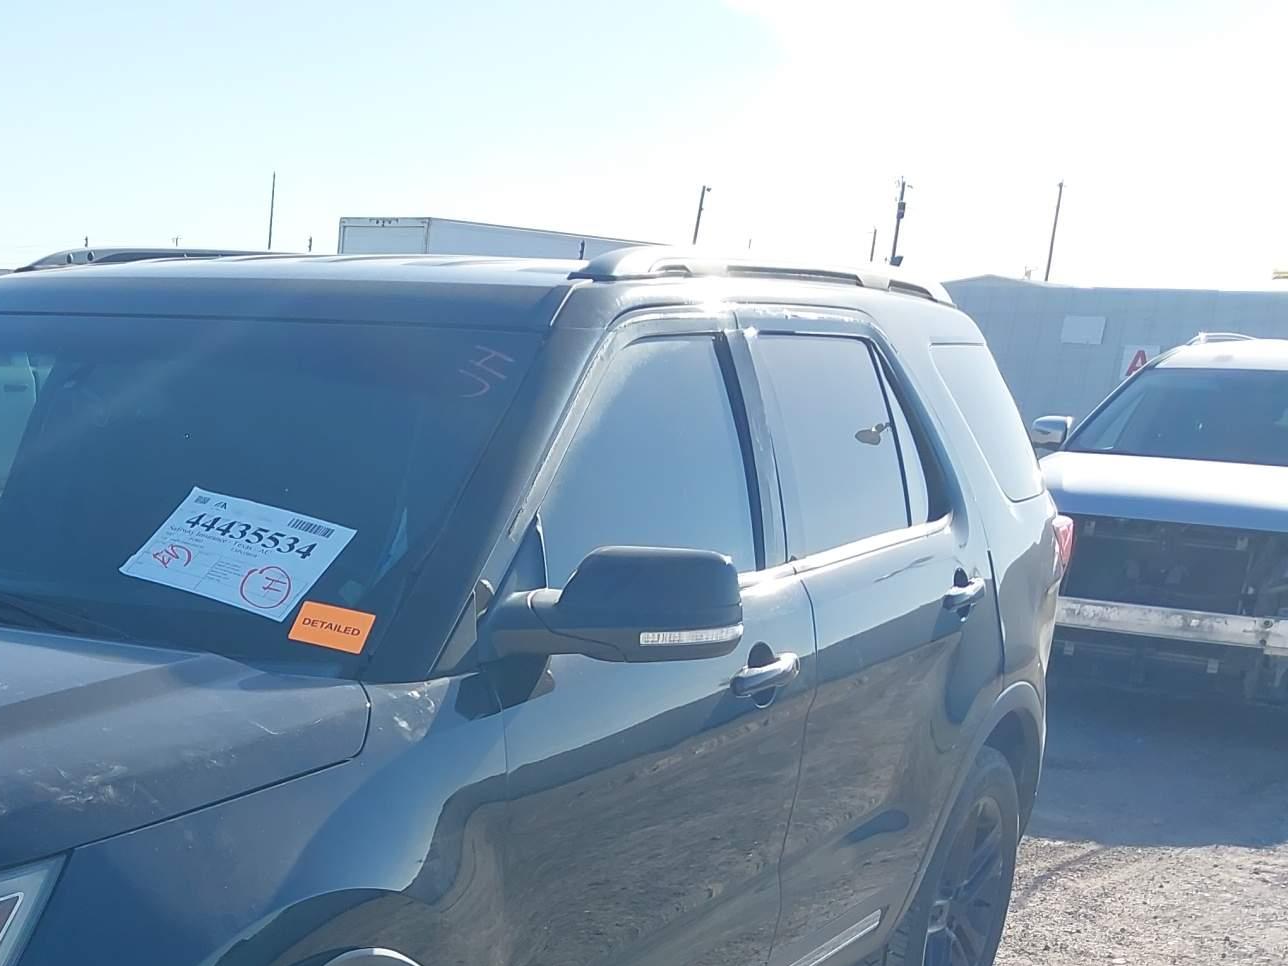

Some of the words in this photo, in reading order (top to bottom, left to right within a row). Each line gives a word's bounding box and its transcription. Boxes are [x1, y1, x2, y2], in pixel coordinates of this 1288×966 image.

[1124, 349, 1148, 377] A
[185, 512, 318, 560] 44435534
[302, 617, 361, 637] DETAILED
